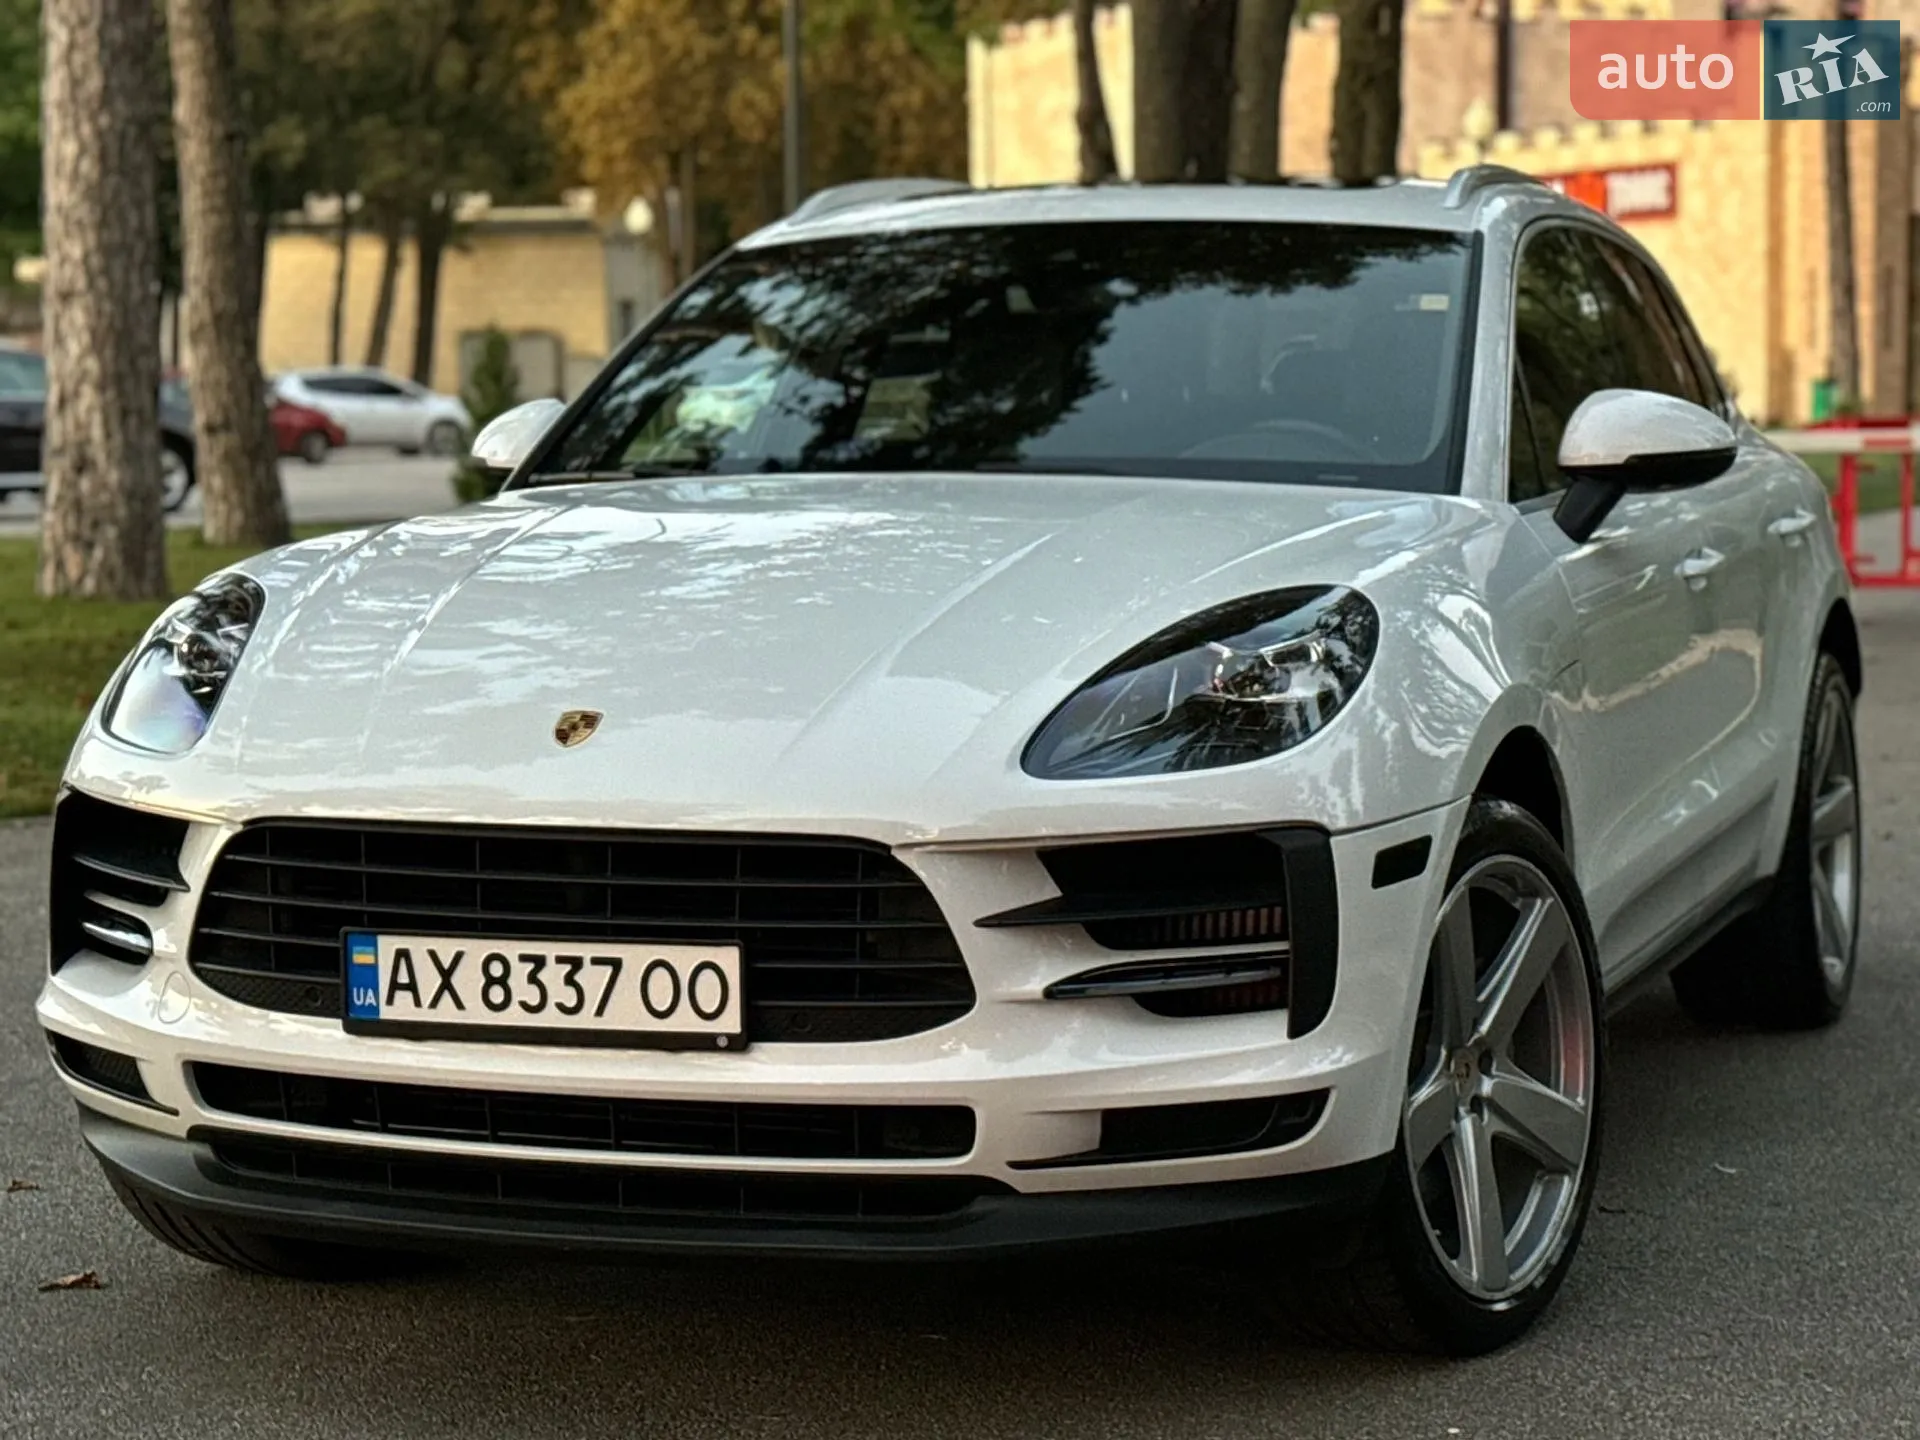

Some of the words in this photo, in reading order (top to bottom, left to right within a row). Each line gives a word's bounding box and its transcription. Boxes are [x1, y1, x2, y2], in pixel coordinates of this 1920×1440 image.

[353, 987, 376, 1006] UA
[385, 948, 466, 1010] AX
[481, 953, 623, 1017] 8337
